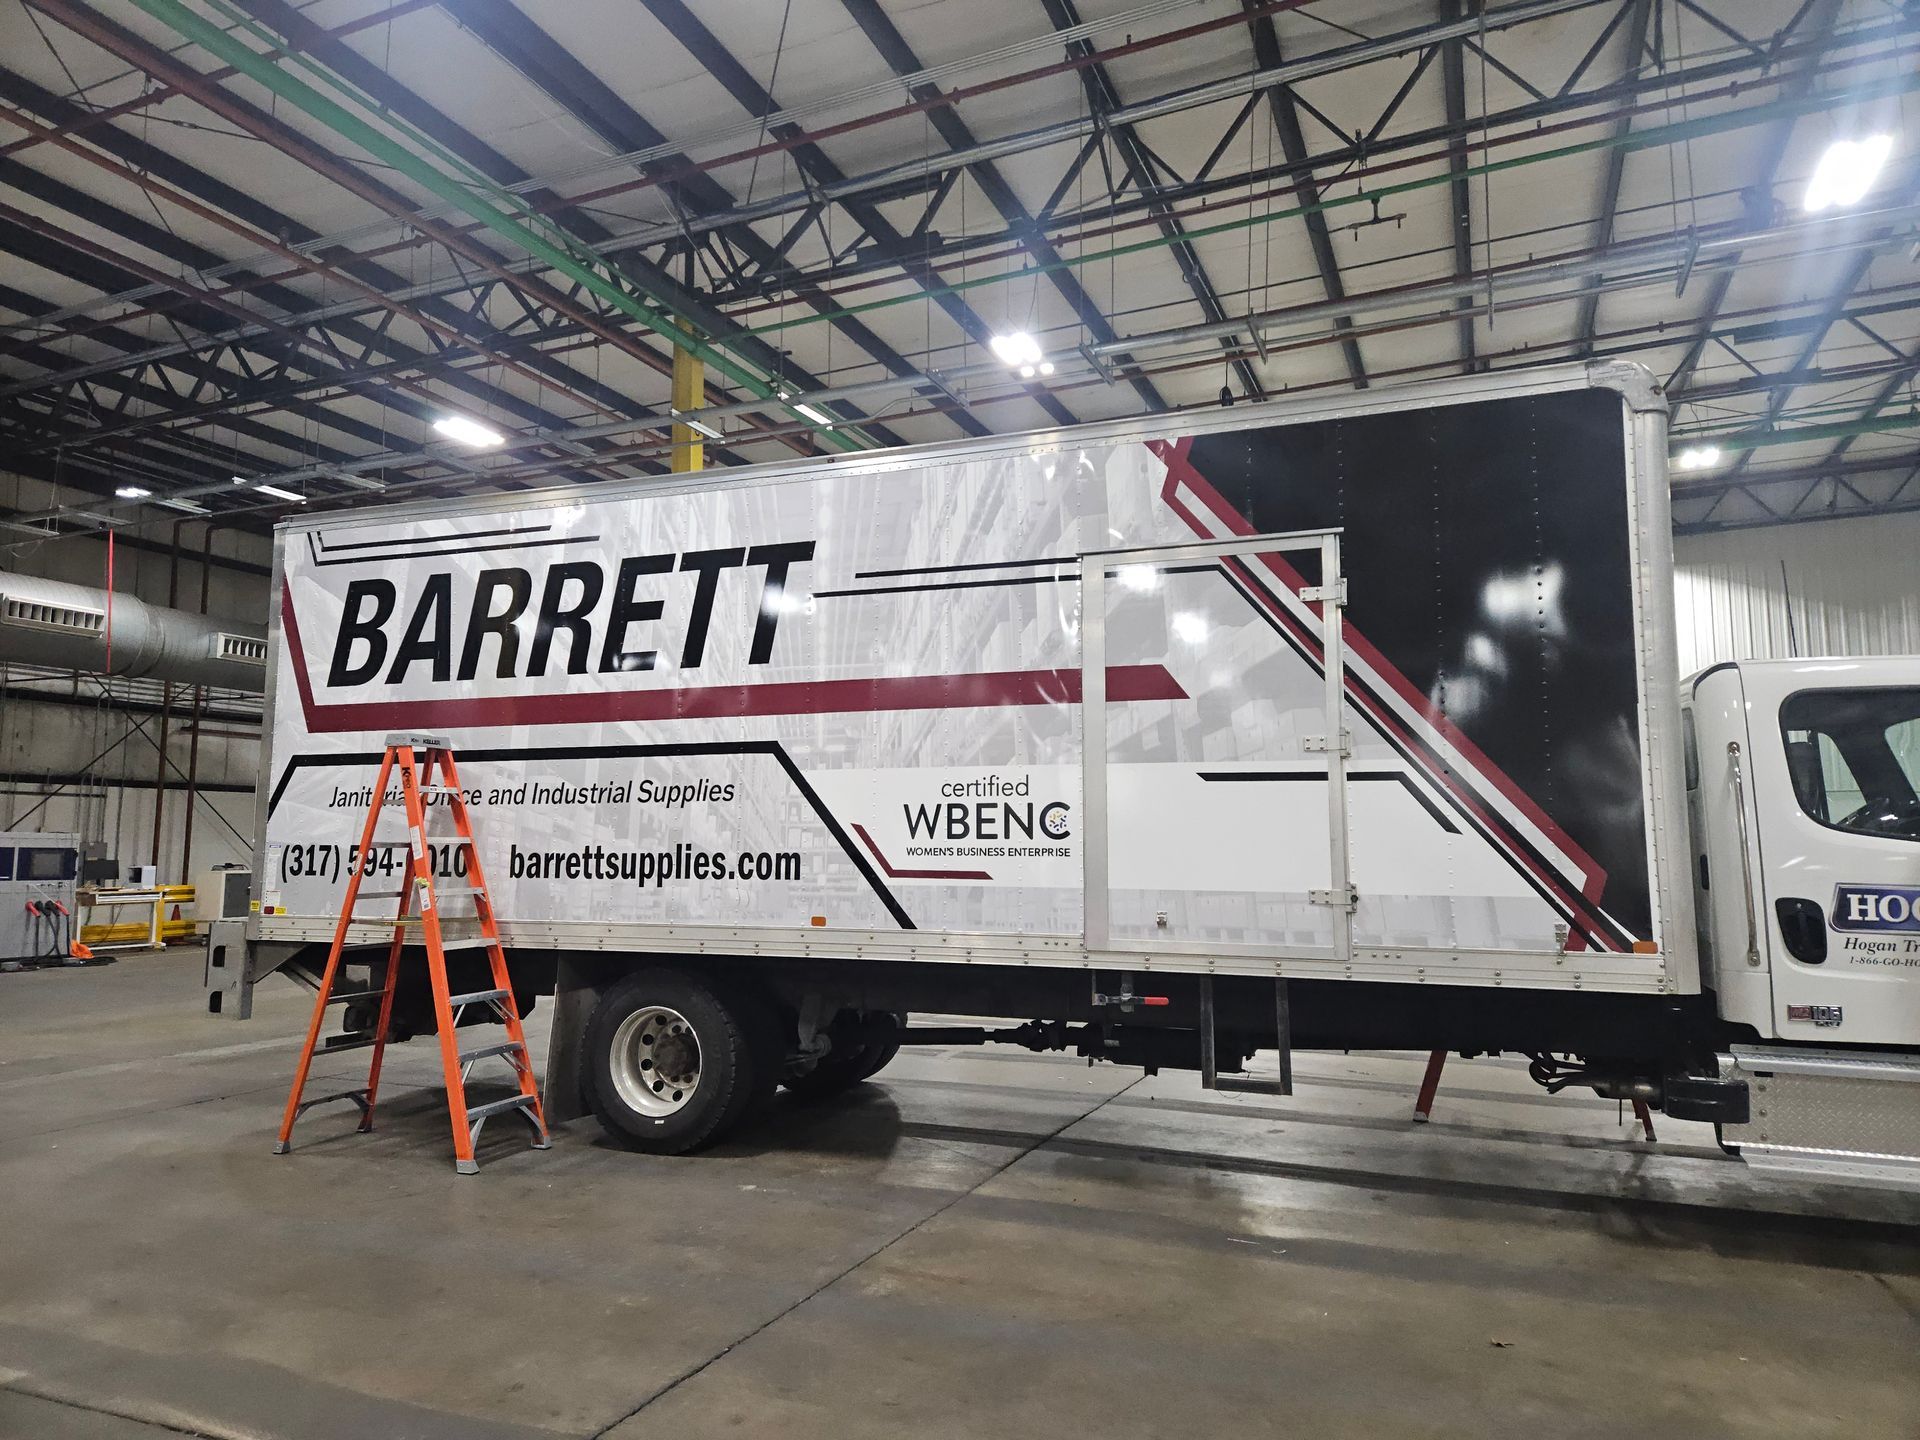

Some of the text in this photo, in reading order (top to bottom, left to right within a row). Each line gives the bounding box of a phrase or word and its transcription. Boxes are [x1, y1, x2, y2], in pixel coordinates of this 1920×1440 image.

[327, 541, 815, 687] BARRETT
[329, 779, 735, 809] Janitria Oce and Industrial Supplies
[941, 774, 1029, 798] certified
[903, 801, 1071, 840] WBENC
[281, 844, 340, 884] (317)
[347, 844, 468, 878] 594-010
[509, 843, 801, 888] barrettsupplies.com
[906, 847, 1071, 857] WOMEN'S BUSINESS ENTERPRISE
[1846, 893, 1920, 923] HO
[1843, 937, 1897, 956] Hogan
